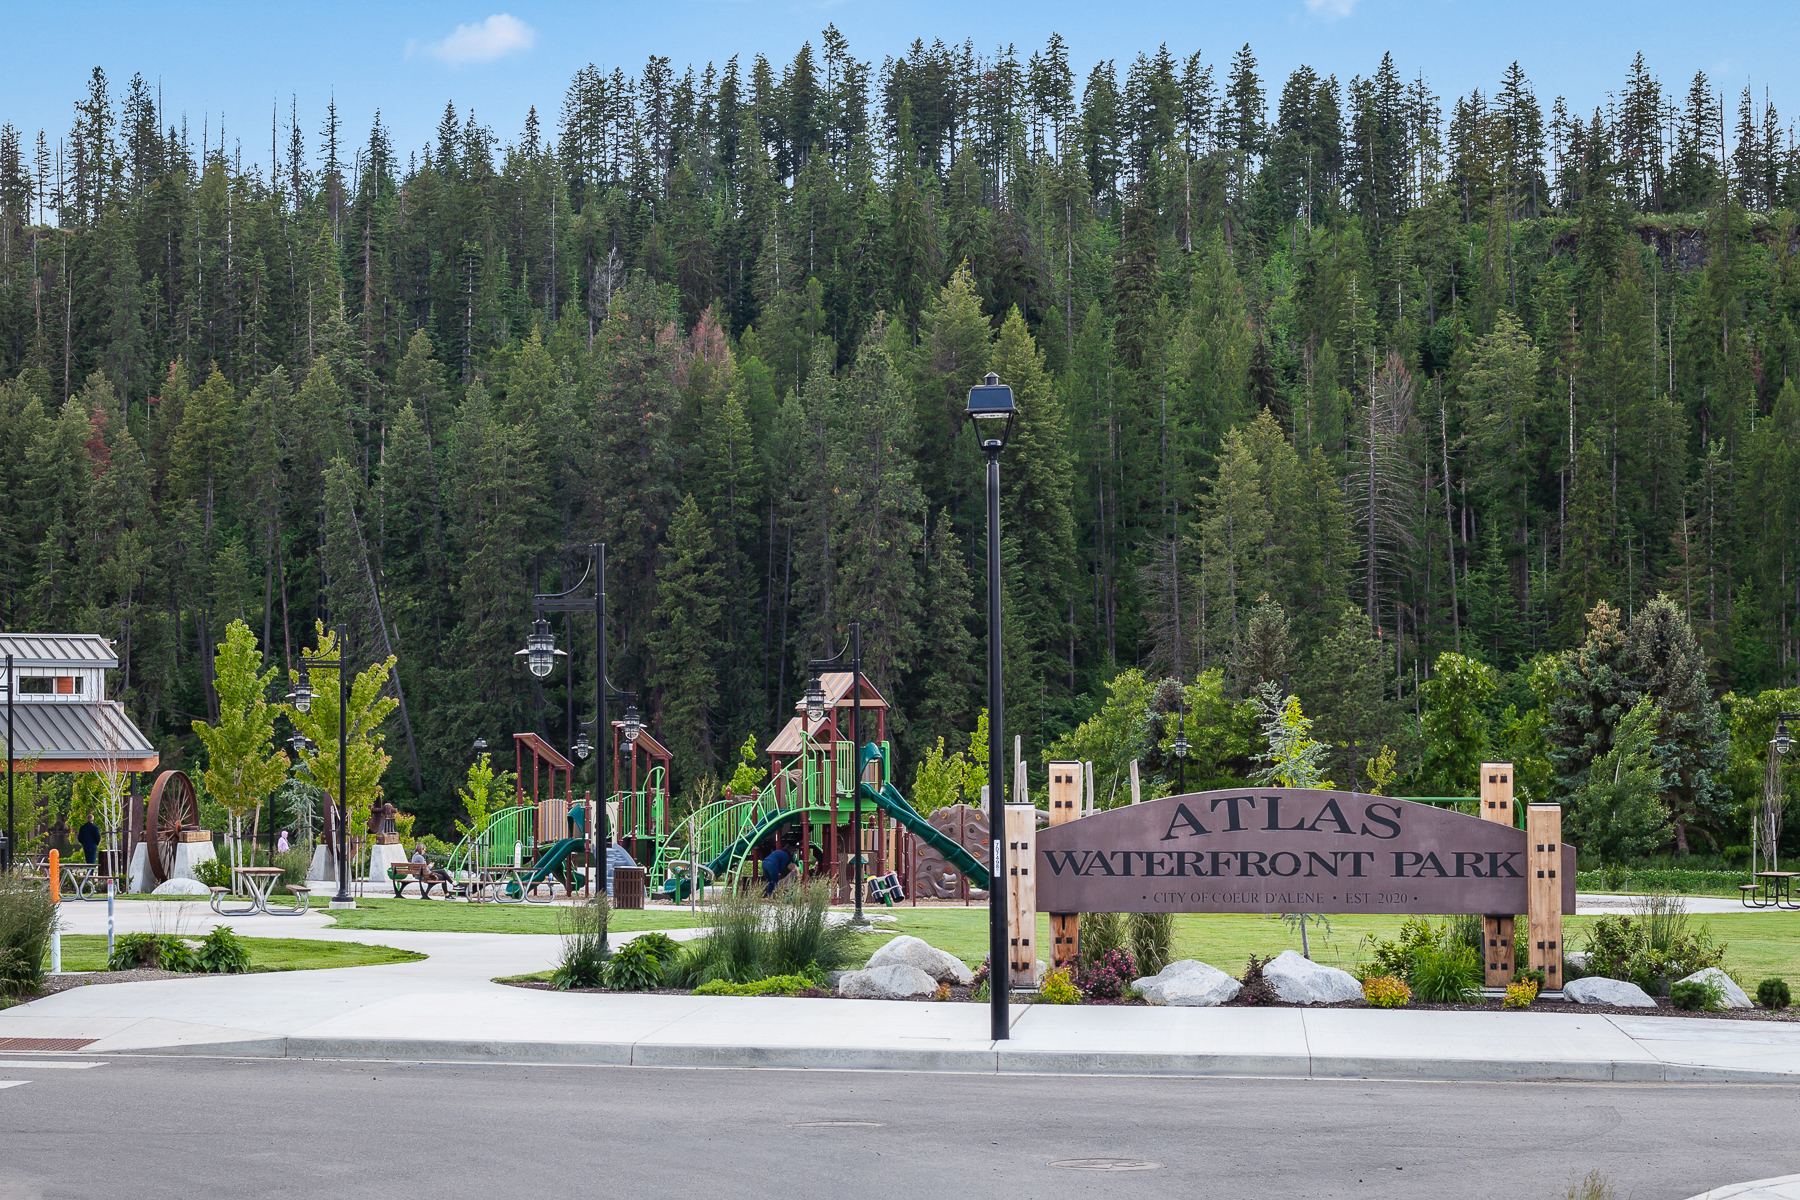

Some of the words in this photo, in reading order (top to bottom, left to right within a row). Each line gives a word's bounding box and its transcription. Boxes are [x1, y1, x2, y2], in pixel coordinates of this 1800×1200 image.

[1160, 796, 1402, 841] ATLAS
[1042, 850, 1375, 878] WATERFRONT
[1390, 851, 1524, 879] PARK
[1153, 892, 1187, 905] CITY
[1190, 892, 1209, 905] OF
[1211, 892, 1260, 905] COEUR
[1265, 891, 1325, 904] D'ALENE
[1345, 892, 1374, 905] EST.
[1377, 892, 1408, 905] 2020
